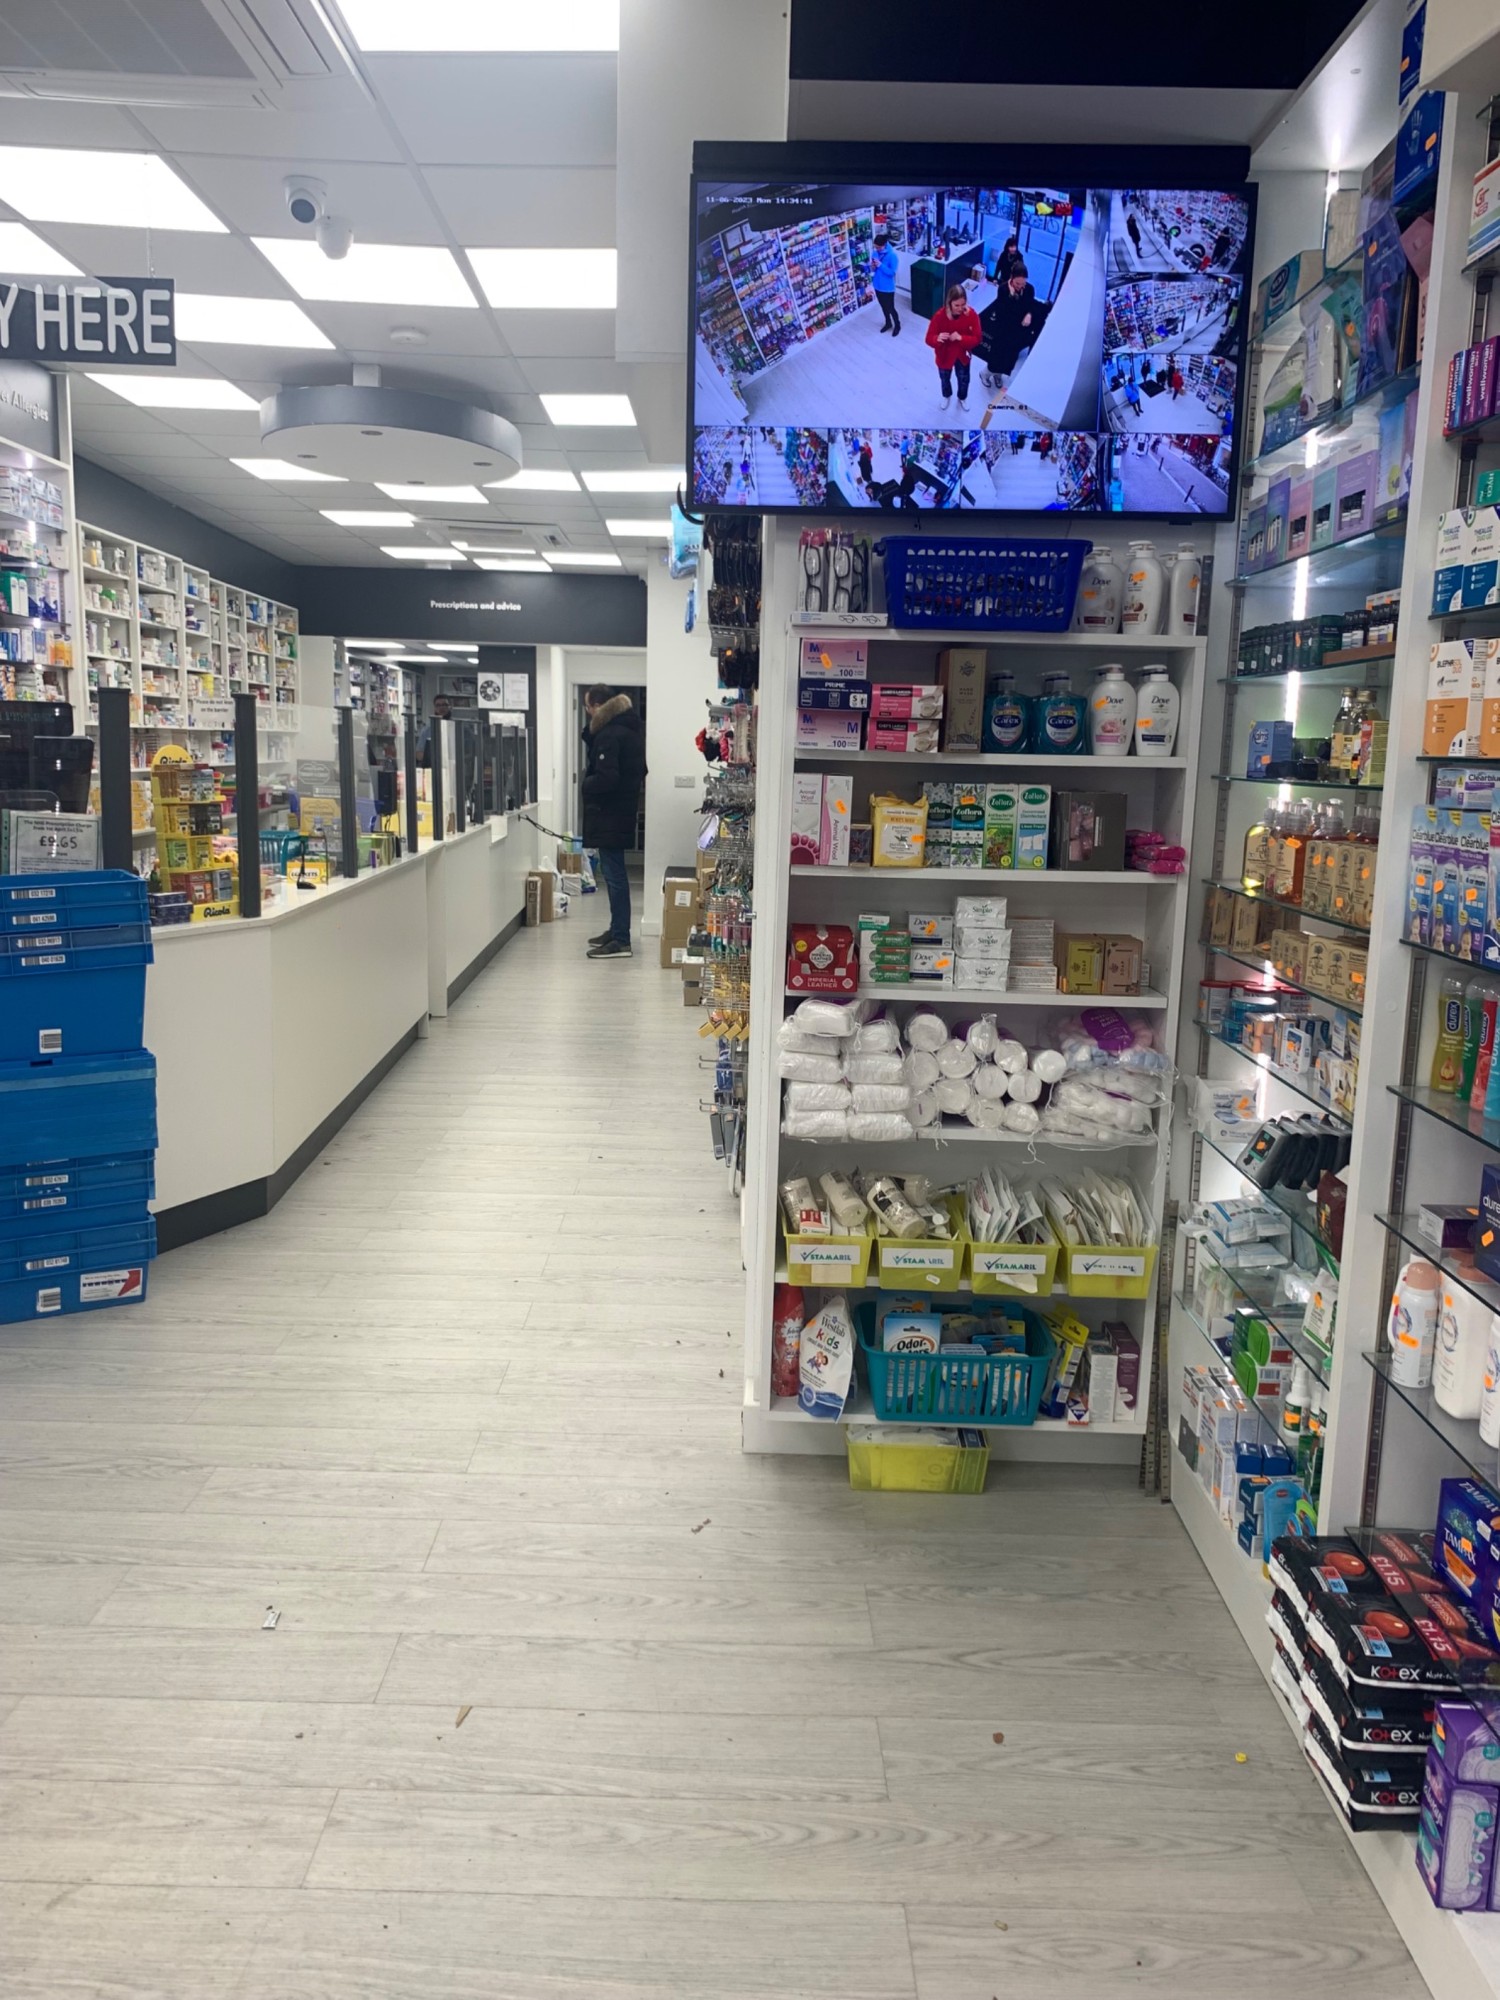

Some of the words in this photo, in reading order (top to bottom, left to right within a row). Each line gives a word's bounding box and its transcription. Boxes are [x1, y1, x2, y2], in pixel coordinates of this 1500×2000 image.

[705, 196, 753, 204] 11-06-2023
[35, 284, 172, 355] HERE
[1480, 344, 1490, 401] wellwoman
[1466, 350, 1475, 406] wellwoman
[1451, 357, 1460, 412] wellwoman
[1091, 576, 1112, 586] Dove
[430, 600, 478, 611] Prescriptions
[480, 601, 495, 610] and
[496, 601, 522, 611] advice
[857, 650, 865, 662] L
[839, 669, 854, 677] 100
[1105, 695, 1124, 705] Dove
[1151, 695, 1170, 705] Dove
[995, 716, 1019, 724] Carex
[1049, 717, 1074, 725] Carex
[847, 722, 858, 734] M
[832, 740, 847, 748] 100
[1024, 792, 1046, 800] Zoflora
[955, 807, 983, 816] Zoflora
[40, 835, 78, 849] £9.65
[1460, 835, 1489, 851] Clearblue
[203, 906, 231, 919] Ricola
[972, 905, 992, 915] Simple
[978, 936, 998, 945] Simple
[914, 952, 933, 961] Dove
[975, 967, 996, 976] Simple
[1448, 1002, 1459, 1030] durex
[1481, 1015, 1489, 1043] durex
[1483, 1195, 1500, 1214] dure
[810, 1253, 852, 1261] STAMARIL
[902, 1256, 945, 1265] STAMRIL
[994, 1262, 1037, 1271] STAMARIL
[821, 1316, 846, 1338] Westlab
[816, 1328, 840, 1349] kids
[1370, 1556, 1406, 1587] £1.15
[1414, 1618, 1452, 1653] £1.15
